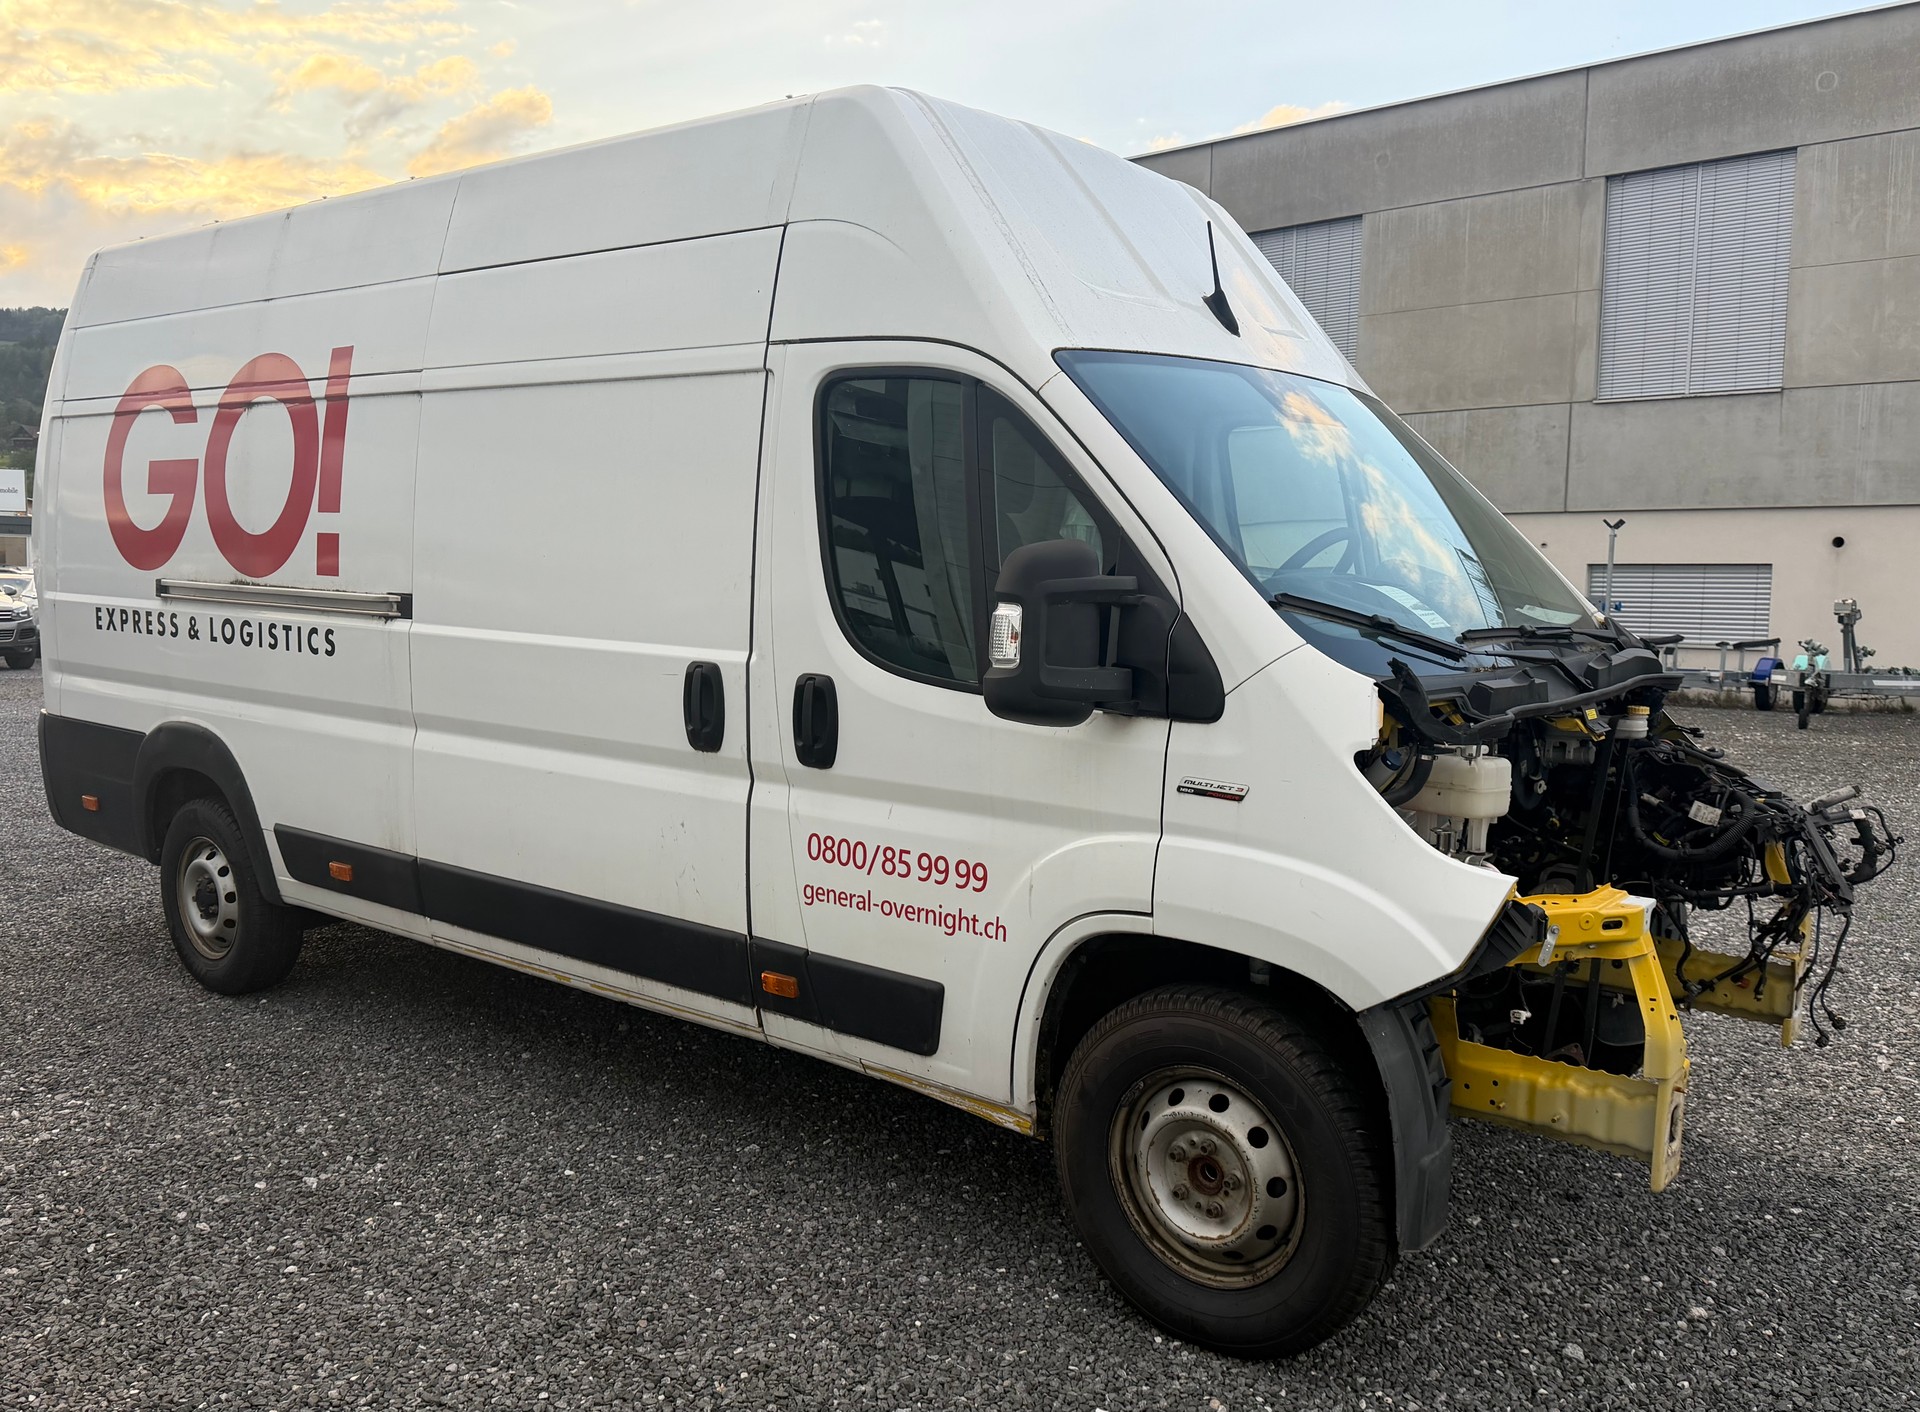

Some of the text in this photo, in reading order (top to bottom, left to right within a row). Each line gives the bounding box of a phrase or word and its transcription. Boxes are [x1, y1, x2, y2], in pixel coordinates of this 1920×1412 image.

[104, 345, 354, 578] GO!
[95, 607, 336, 657] EXPRESS & LOGISTICS
[1183, 780, 1234, 791] MULTIJET
[803, 883, 1007, 942] general-overnight.ch
